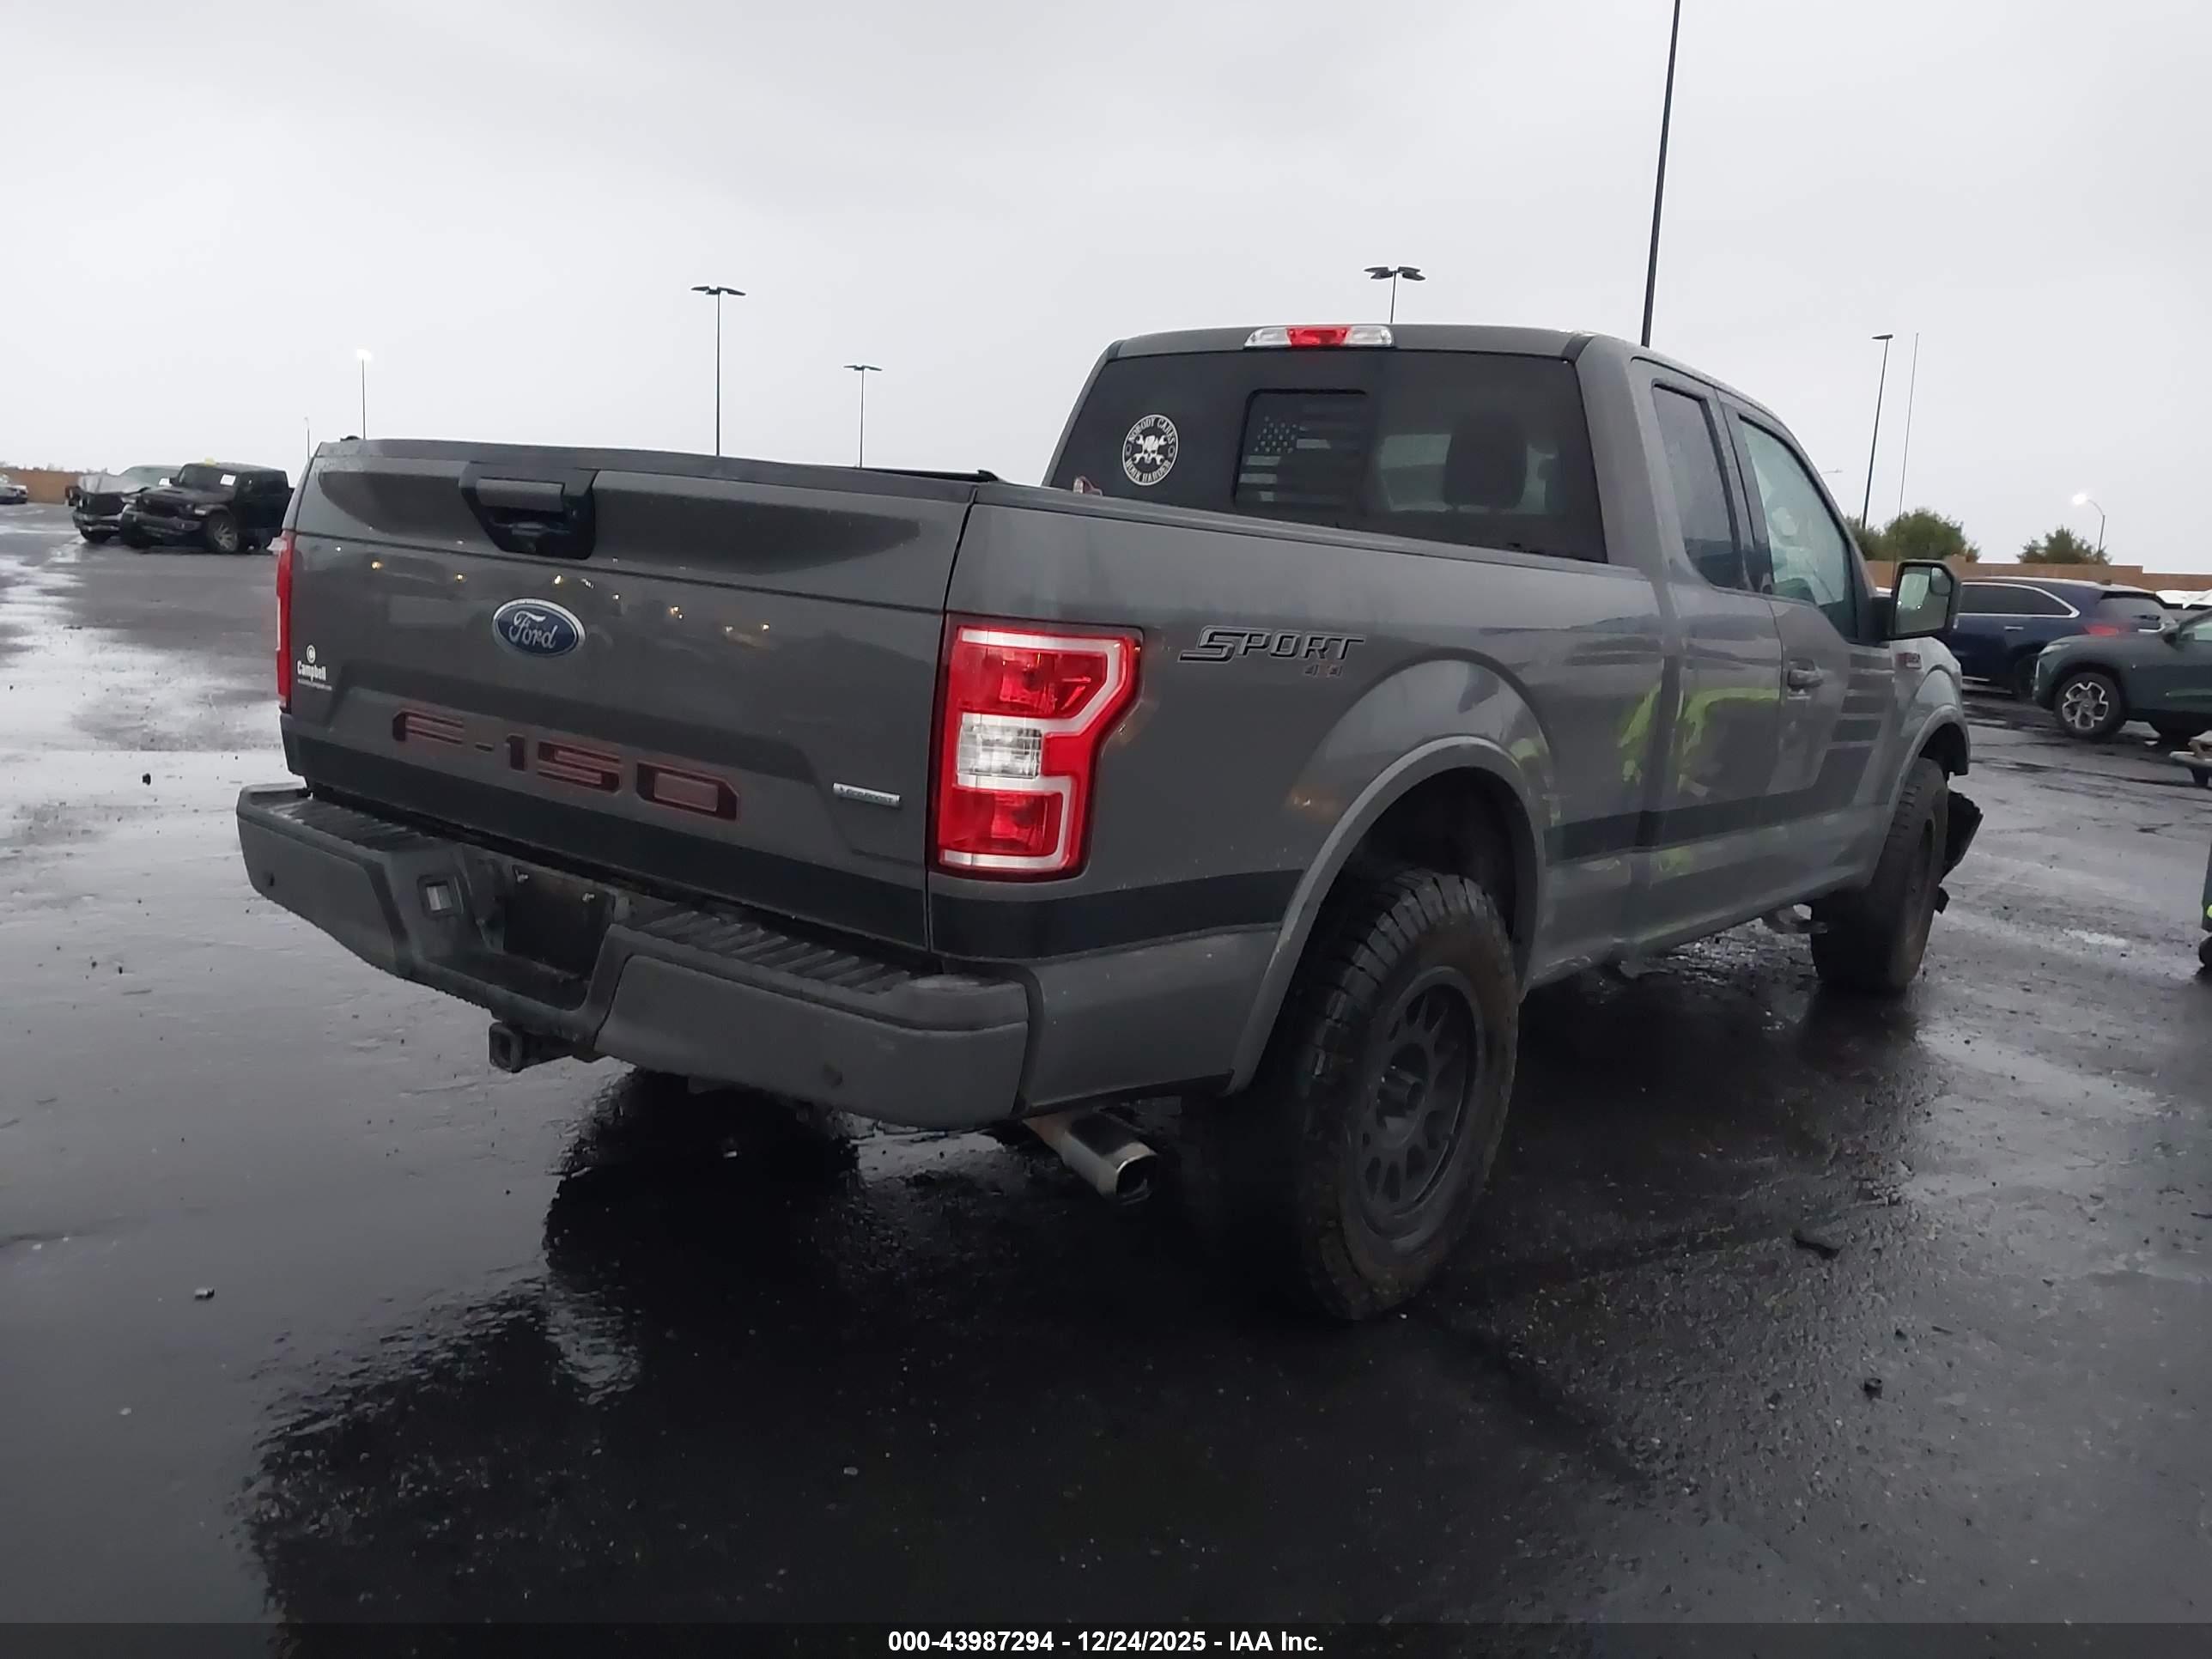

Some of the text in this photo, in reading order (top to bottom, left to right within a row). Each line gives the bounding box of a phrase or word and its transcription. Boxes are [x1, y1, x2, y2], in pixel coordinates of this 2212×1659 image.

[1128, 417, 1176, 445] NOBODY CARES
[508, 611, 558, 649] Ford
[1177, 625, 1367, 663] SPORT
[297, 659, 326, 682] Campbell
[392, 709, 739, 822] F-150
